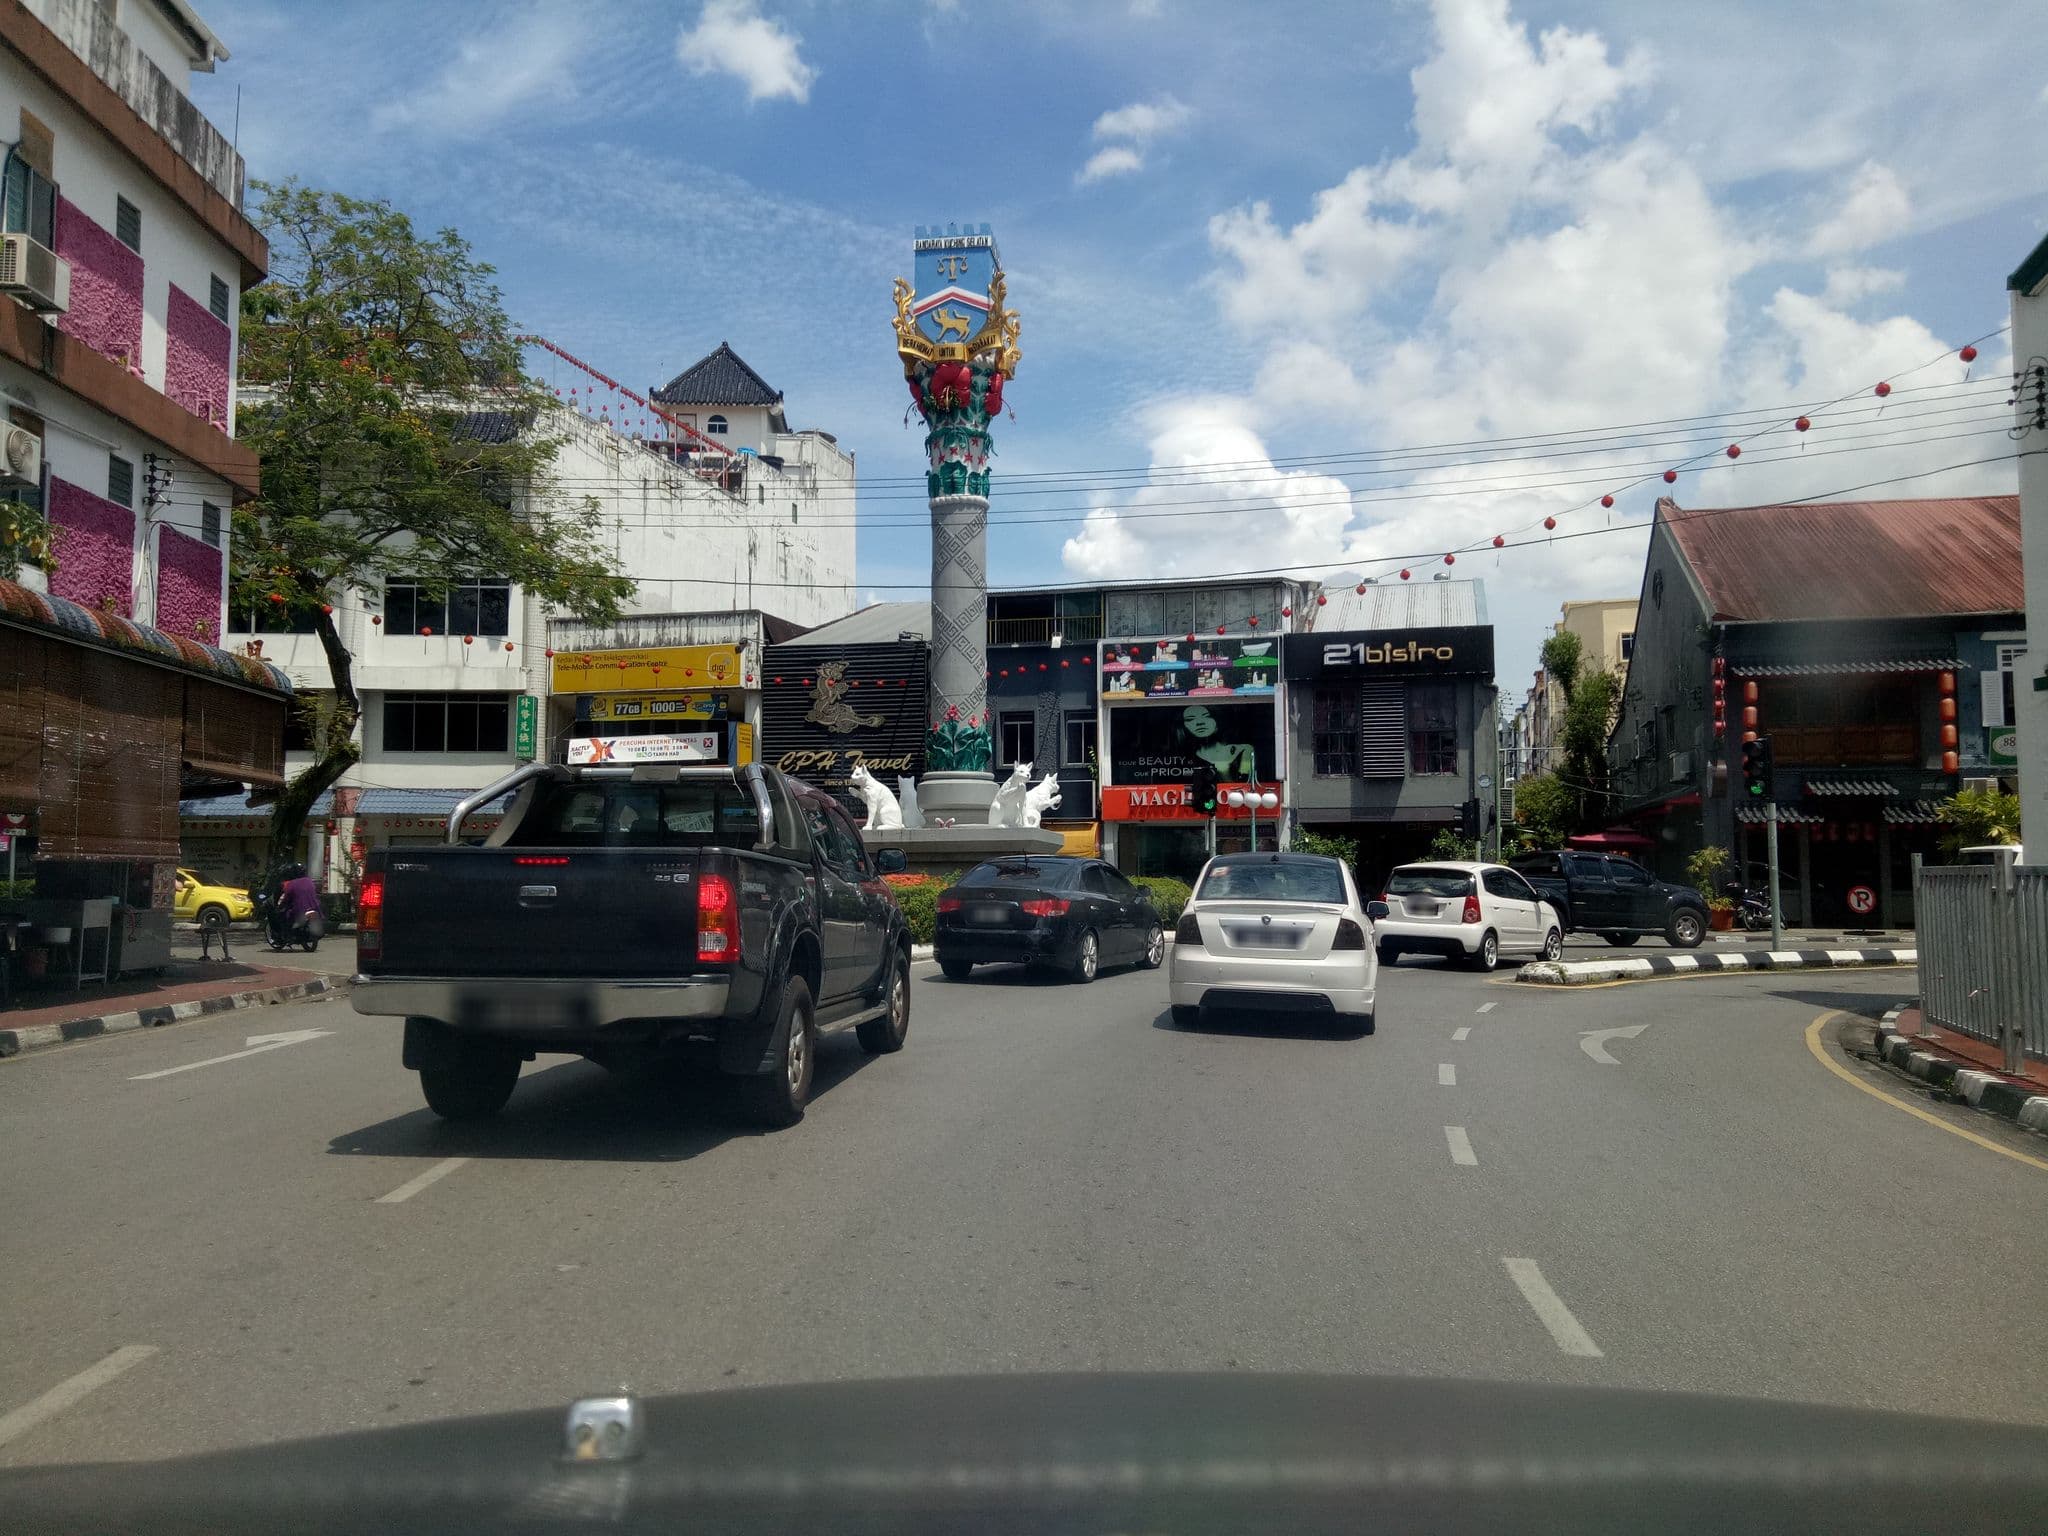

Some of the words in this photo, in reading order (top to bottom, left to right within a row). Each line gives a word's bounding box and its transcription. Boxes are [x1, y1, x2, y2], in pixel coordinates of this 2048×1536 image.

[615, 703, 640, 714] 77GB
[651, 702, 675, 713] 1000
[775, 751, 838, 773] CPH
[1138, 756, 1186, 766] BEAUTY
